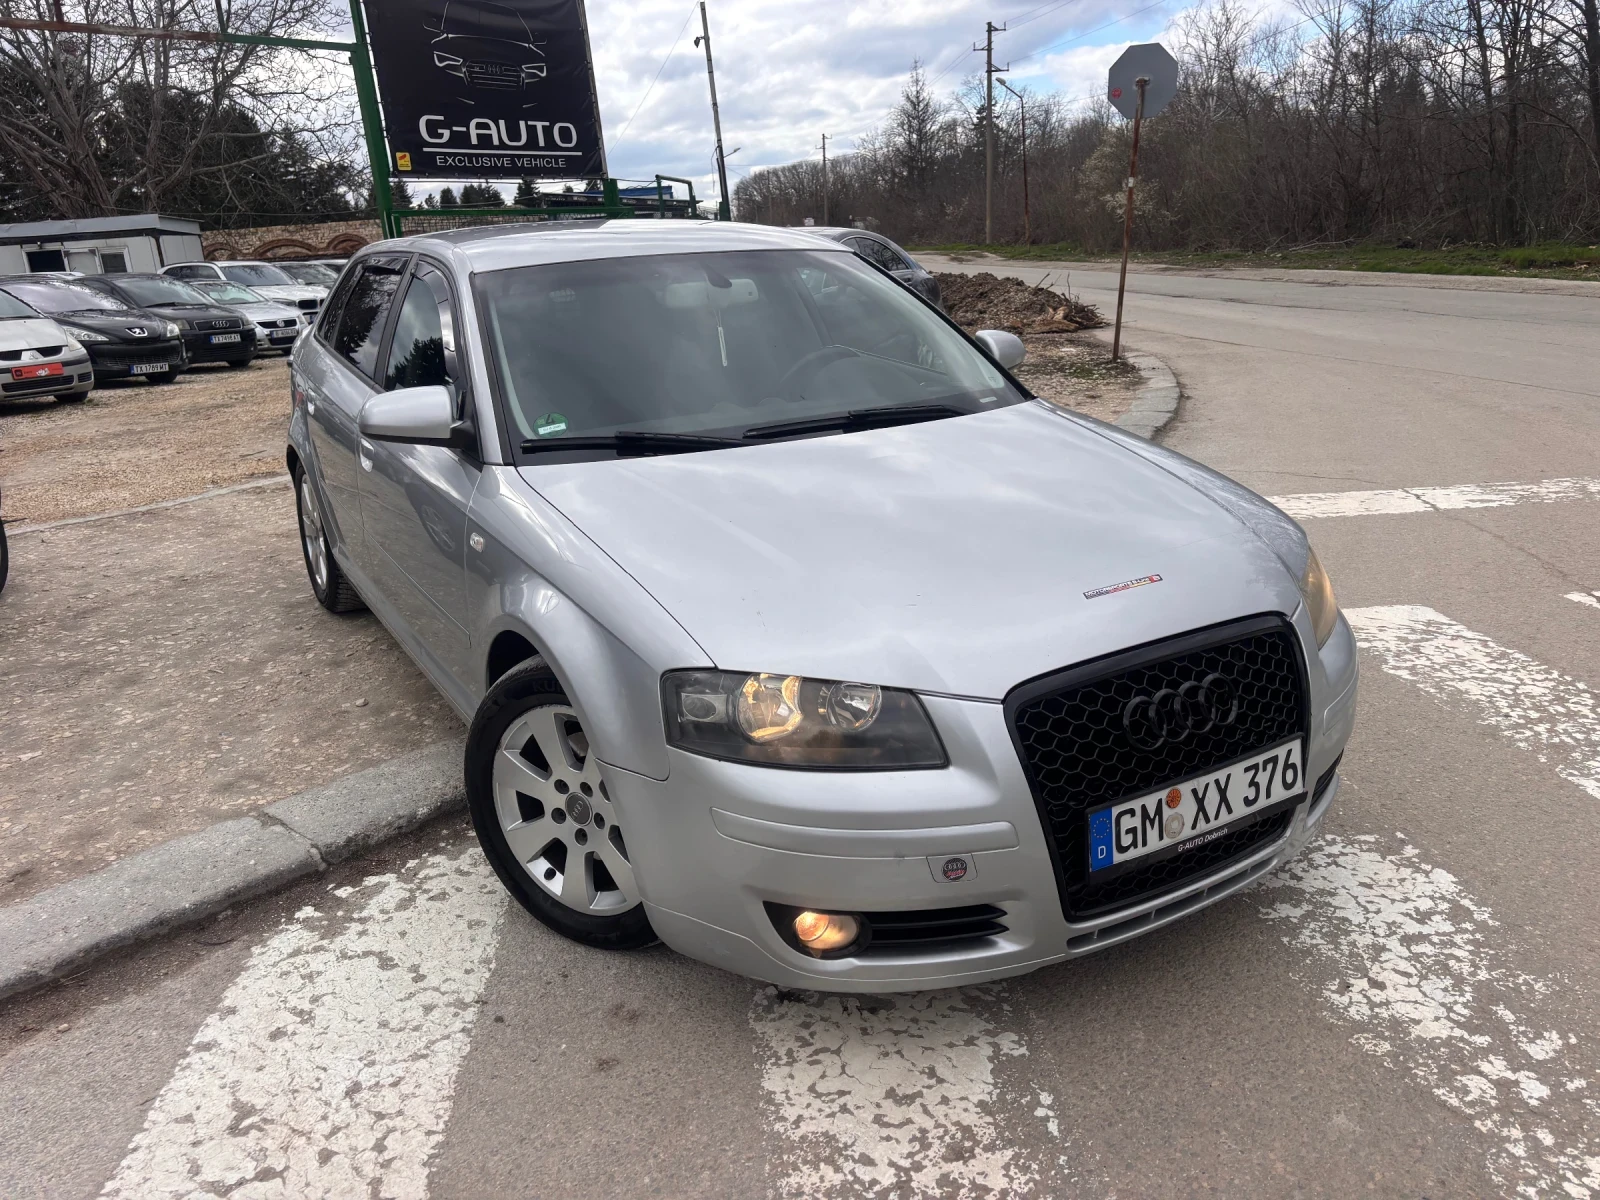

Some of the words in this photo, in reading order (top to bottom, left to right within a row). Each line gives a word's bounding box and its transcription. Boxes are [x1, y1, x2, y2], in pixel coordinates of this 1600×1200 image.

[418, 114, 577, 148] G-AUTO
[436, 156, 512, 167] EXCLUSIVE
[514, 157, 566, 168] VEHICLE
[1098, 846, 1106, 859] D
[1114, 797, 1164, 854] GM
[1190, 773, 1233, 830] XX
[1243, 748, 1298, 807] 376
[1178, 837, 1204, 852] G-AUTO
[1204, 827, 1228, 842] Dobrich
